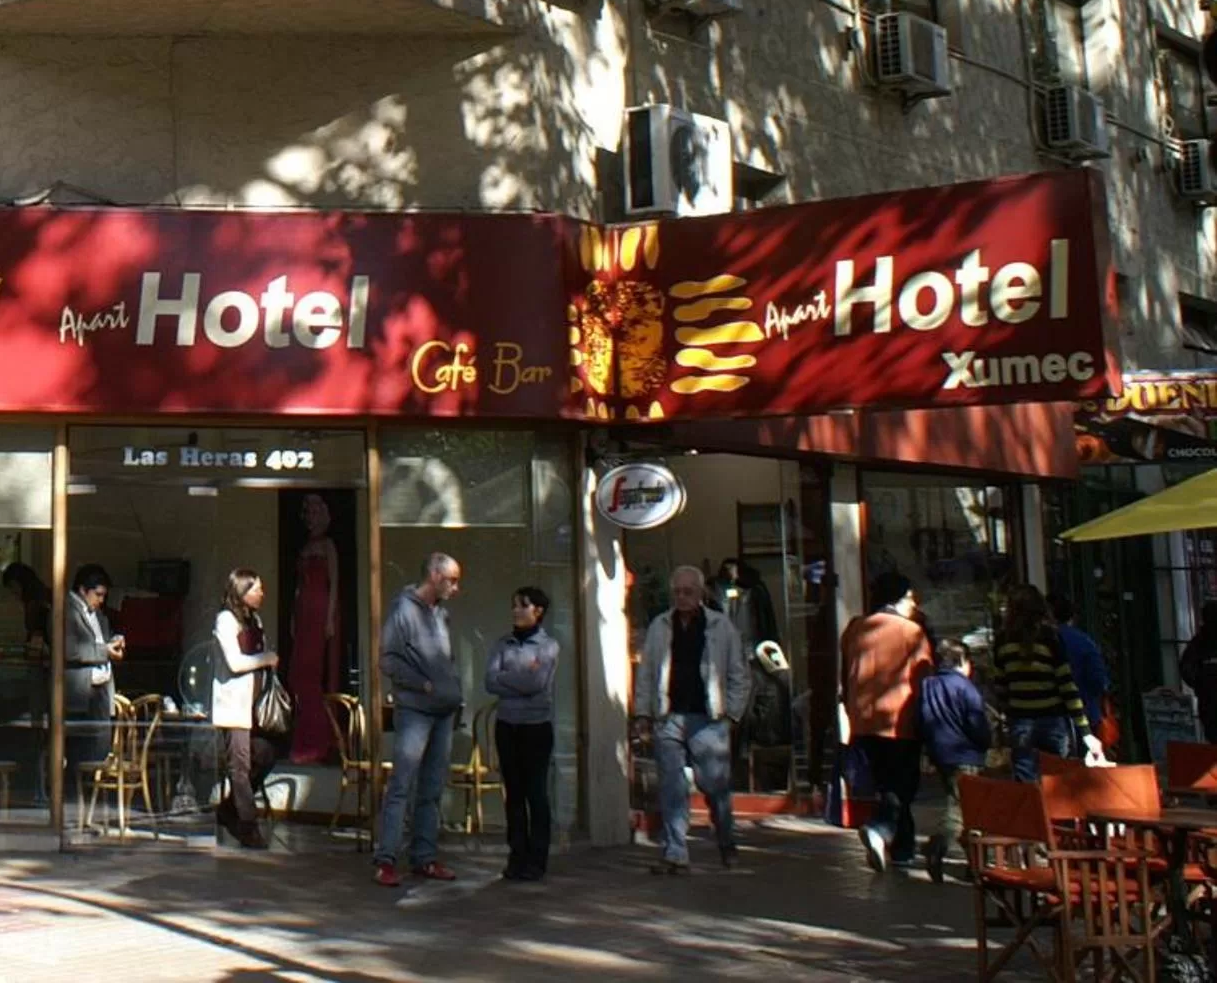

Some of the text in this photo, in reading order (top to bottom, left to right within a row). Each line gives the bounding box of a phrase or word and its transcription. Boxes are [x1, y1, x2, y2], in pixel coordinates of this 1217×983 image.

[59, 271, 370, 349] Apart Hotel
[764, 238, 1070, 341] Apart Hotel
[412, 340, 553, 394] Café Bar
[941, 351, 1095, 390] Xumec
[123, 446, 314, 470] Las Heras 402
